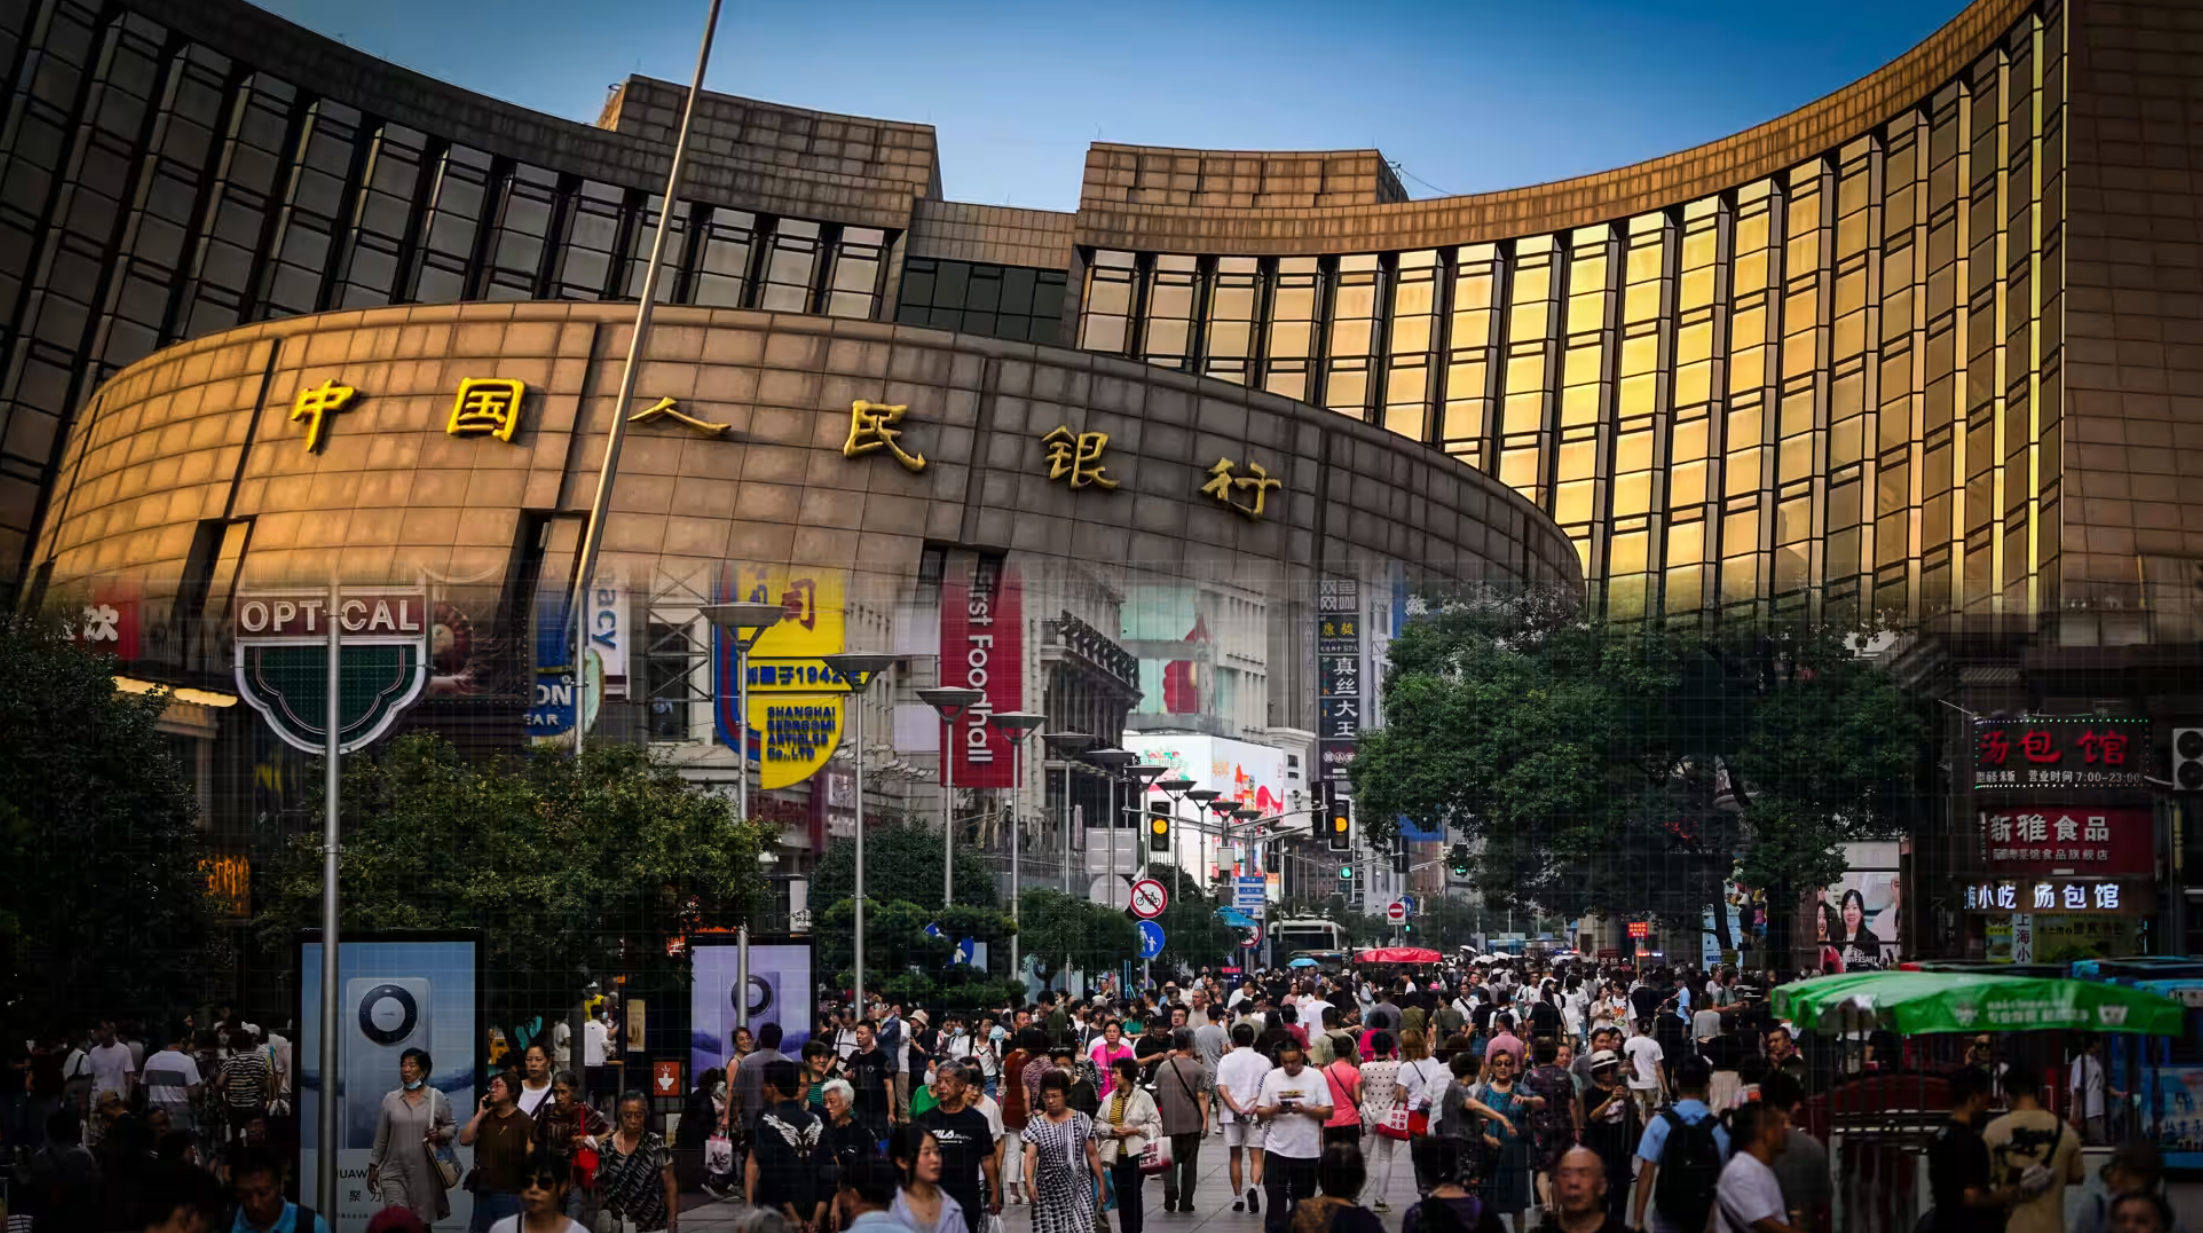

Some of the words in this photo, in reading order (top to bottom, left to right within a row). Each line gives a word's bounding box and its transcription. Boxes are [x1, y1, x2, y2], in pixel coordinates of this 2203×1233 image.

[290, 377, 1282, 520] 中国人民银行
[241, 600, 420, 632] OPTCAL
[767, 706, 836, 718] SHANGHAI
[968, 635, 993, 762] Foodhall
[1333, 656, 1358, 737] 真丝大王
[1979, 729, 2129, 765] 汤包馆
[2027, 769, 2073, 783] 营业时间
[1989, 813, 2110, 843] 新雅食品
[2033, 883, 2120, 909] 汤包馆
[338, 1169, 369, 1179] UAW
